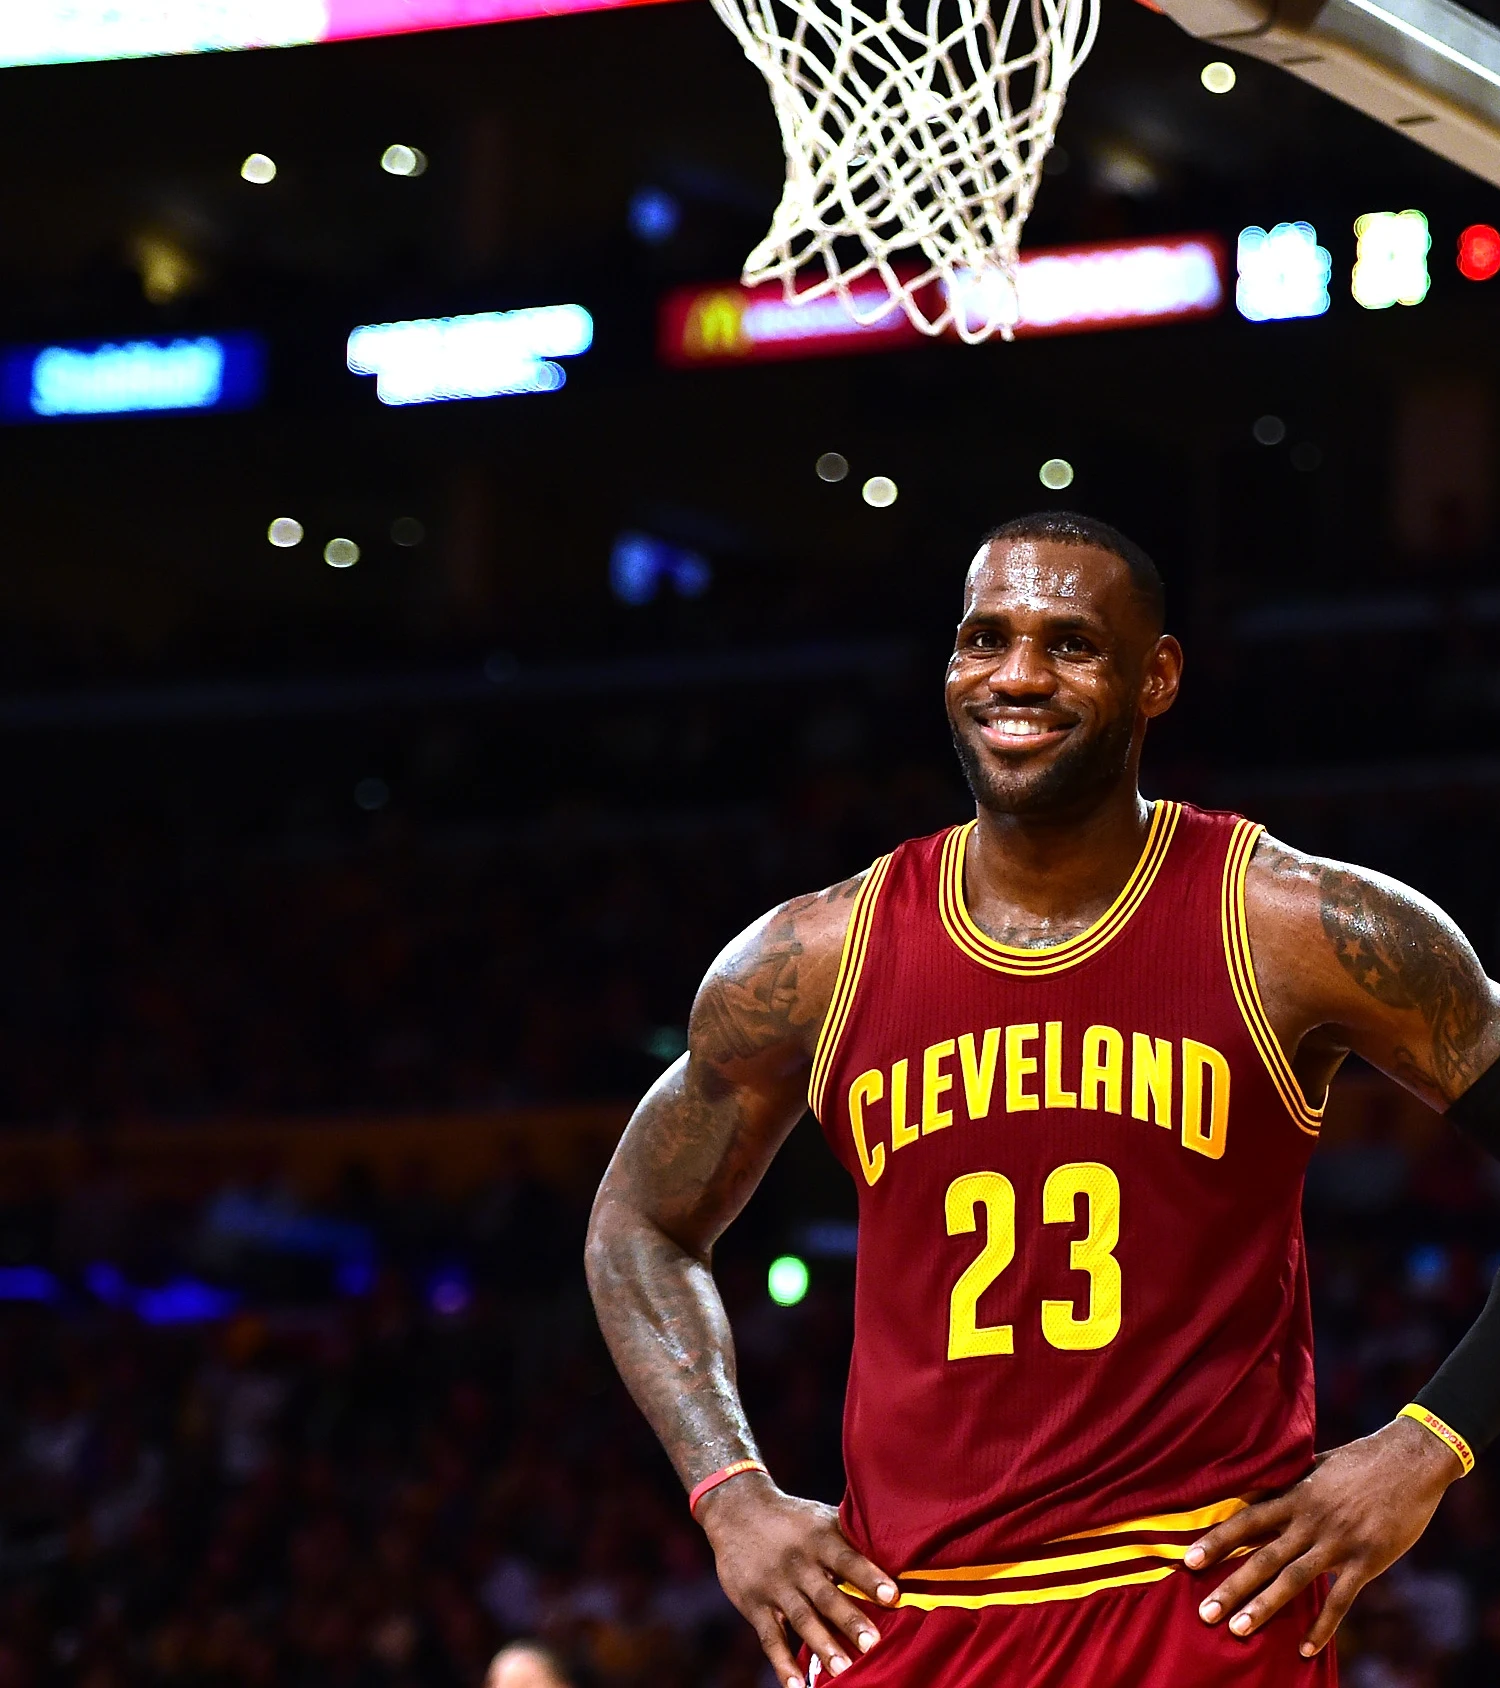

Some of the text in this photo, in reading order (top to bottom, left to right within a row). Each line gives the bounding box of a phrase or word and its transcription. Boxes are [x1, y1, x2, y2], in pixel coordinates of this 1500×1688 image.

[848, 1020, 1231, 1187] CLEVELAND
[944, 1161, 1122, 1361] 23
[1423, 1413, 1470, 1459] PROMISE
